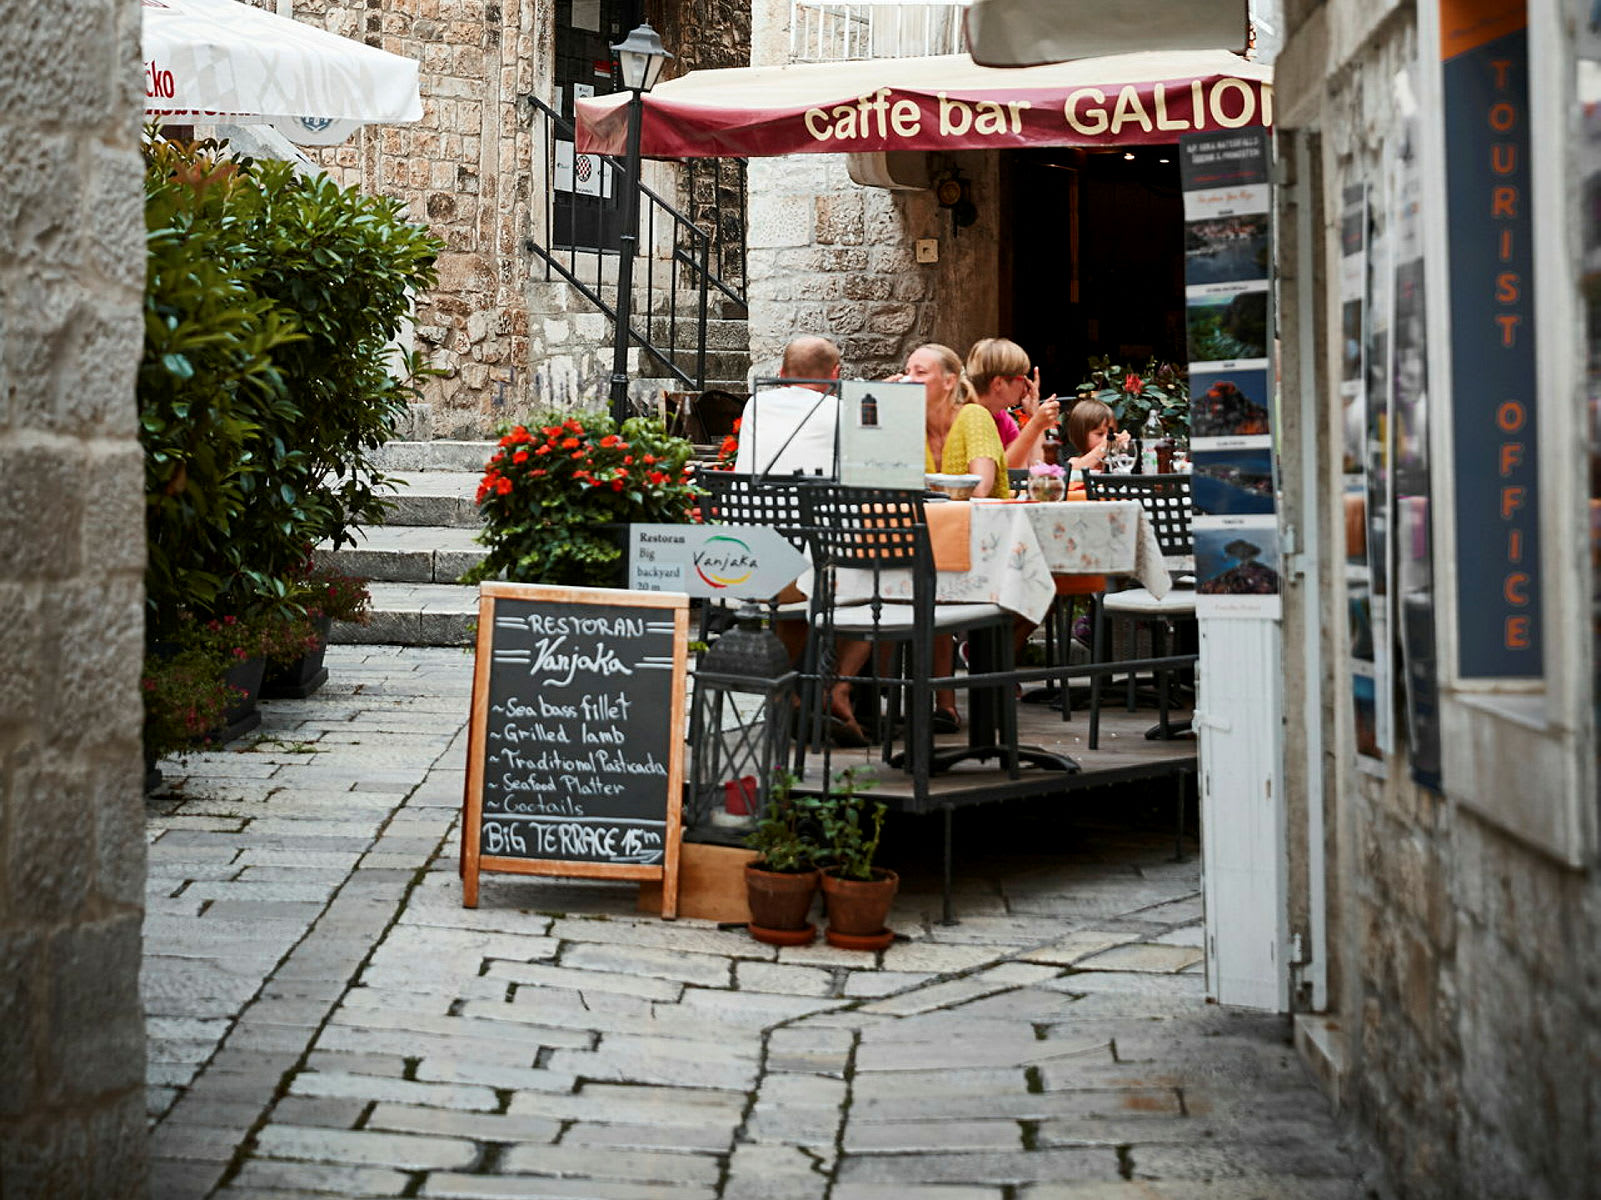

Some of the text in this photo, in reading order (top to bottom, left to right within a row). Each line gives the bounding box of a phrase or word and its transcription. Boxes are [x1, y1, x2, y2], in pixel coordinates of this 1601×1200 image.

[804, 87, 922, 142] caffe
[938, 91, 1032, 137] bar
[1488, 60, 1531, 649] TOURIST OFFICE
[639, 532, 686, 544] Restoran
[639, 547, 656, 562] Big
[693, 551, 759, 571] Vanjaka
[636, 564, 681, 581] backyard
[528, 613, 645, 638] RESTORAN
[529, 635, 633, 687] Vanjaka
[505, 691, 632, 721] Sea bass fillet
[504, 722, 626, 745] Grilled lamb
[501, 747, 597, 774] Traditional
[502, 772, 626, 795] Seafood Platter
[504, 793, 585, 816] Coctails
[528, 821, 620, 857] TERRACE
